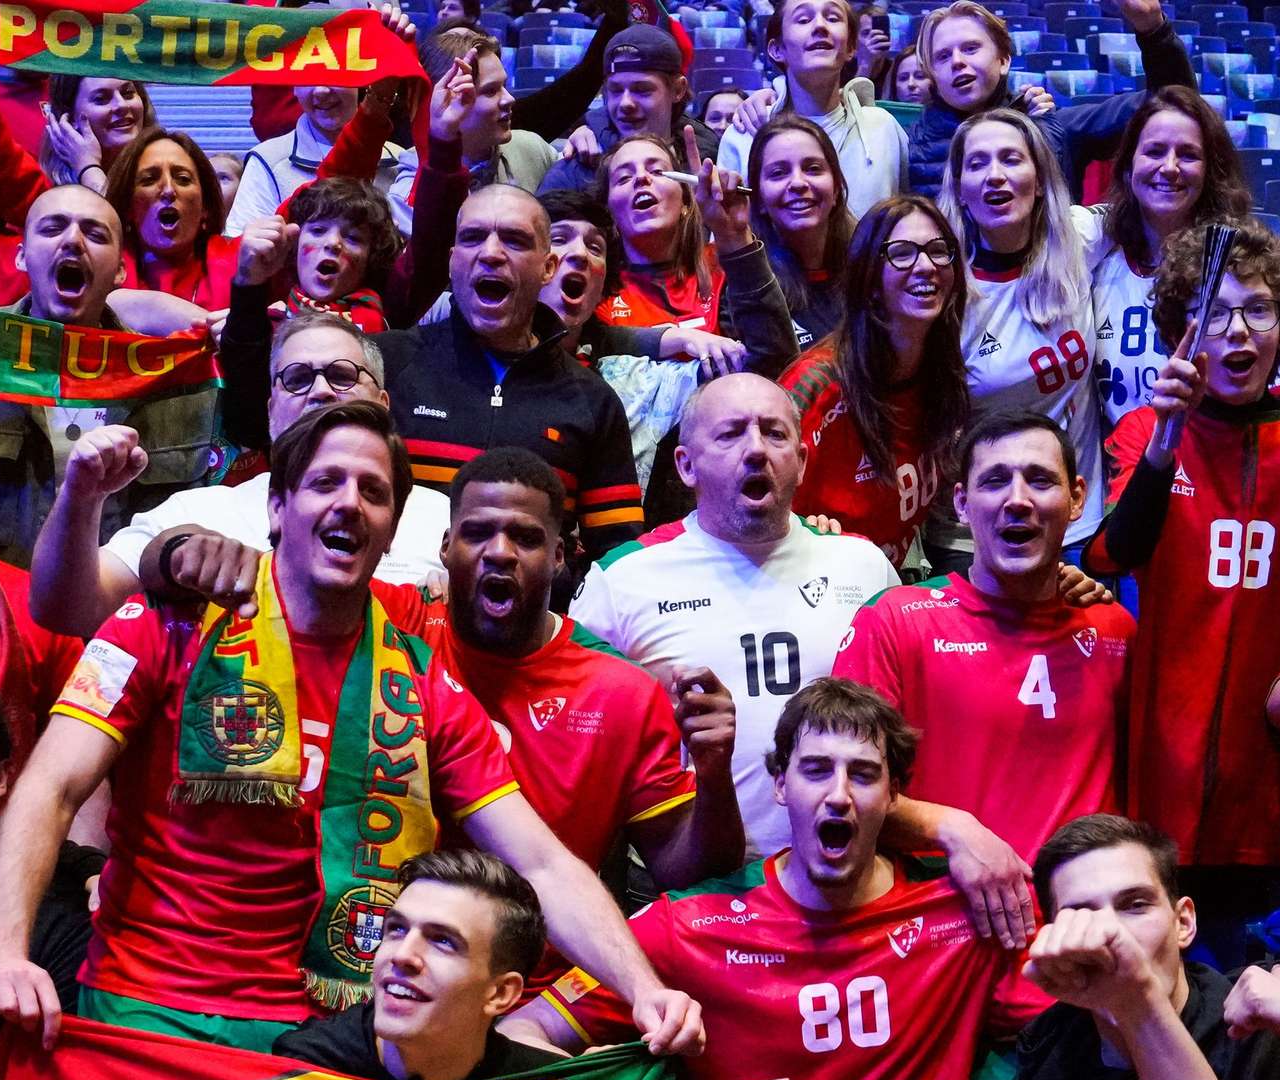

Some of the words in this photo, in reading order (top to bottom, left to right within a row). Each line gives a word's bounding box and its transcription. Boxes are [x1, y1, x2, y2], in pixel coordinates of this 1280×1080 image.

[1096, 331, 1115, 341] SELECT
[978, 342, 1004, 358] SELECT
[1028, 330, 1089, 394] 88
[413, 405, 448, 419] ellesse
[1208, 518, 1277, 590] 88
[657, 596, 712, 615] Kempa
[900, 597, 961, 614] monchique
[933, 638, 988, 655] Kempa
[739, 631, 801, 698] 10
[1017, 655, 1057, 720] 4
[353, 667, 425, 885] FORÇA
[691, 912, 762, 930] monchique
[725, 949, 786, 969] Kempa
[798, 976, 891, 1053] 80
